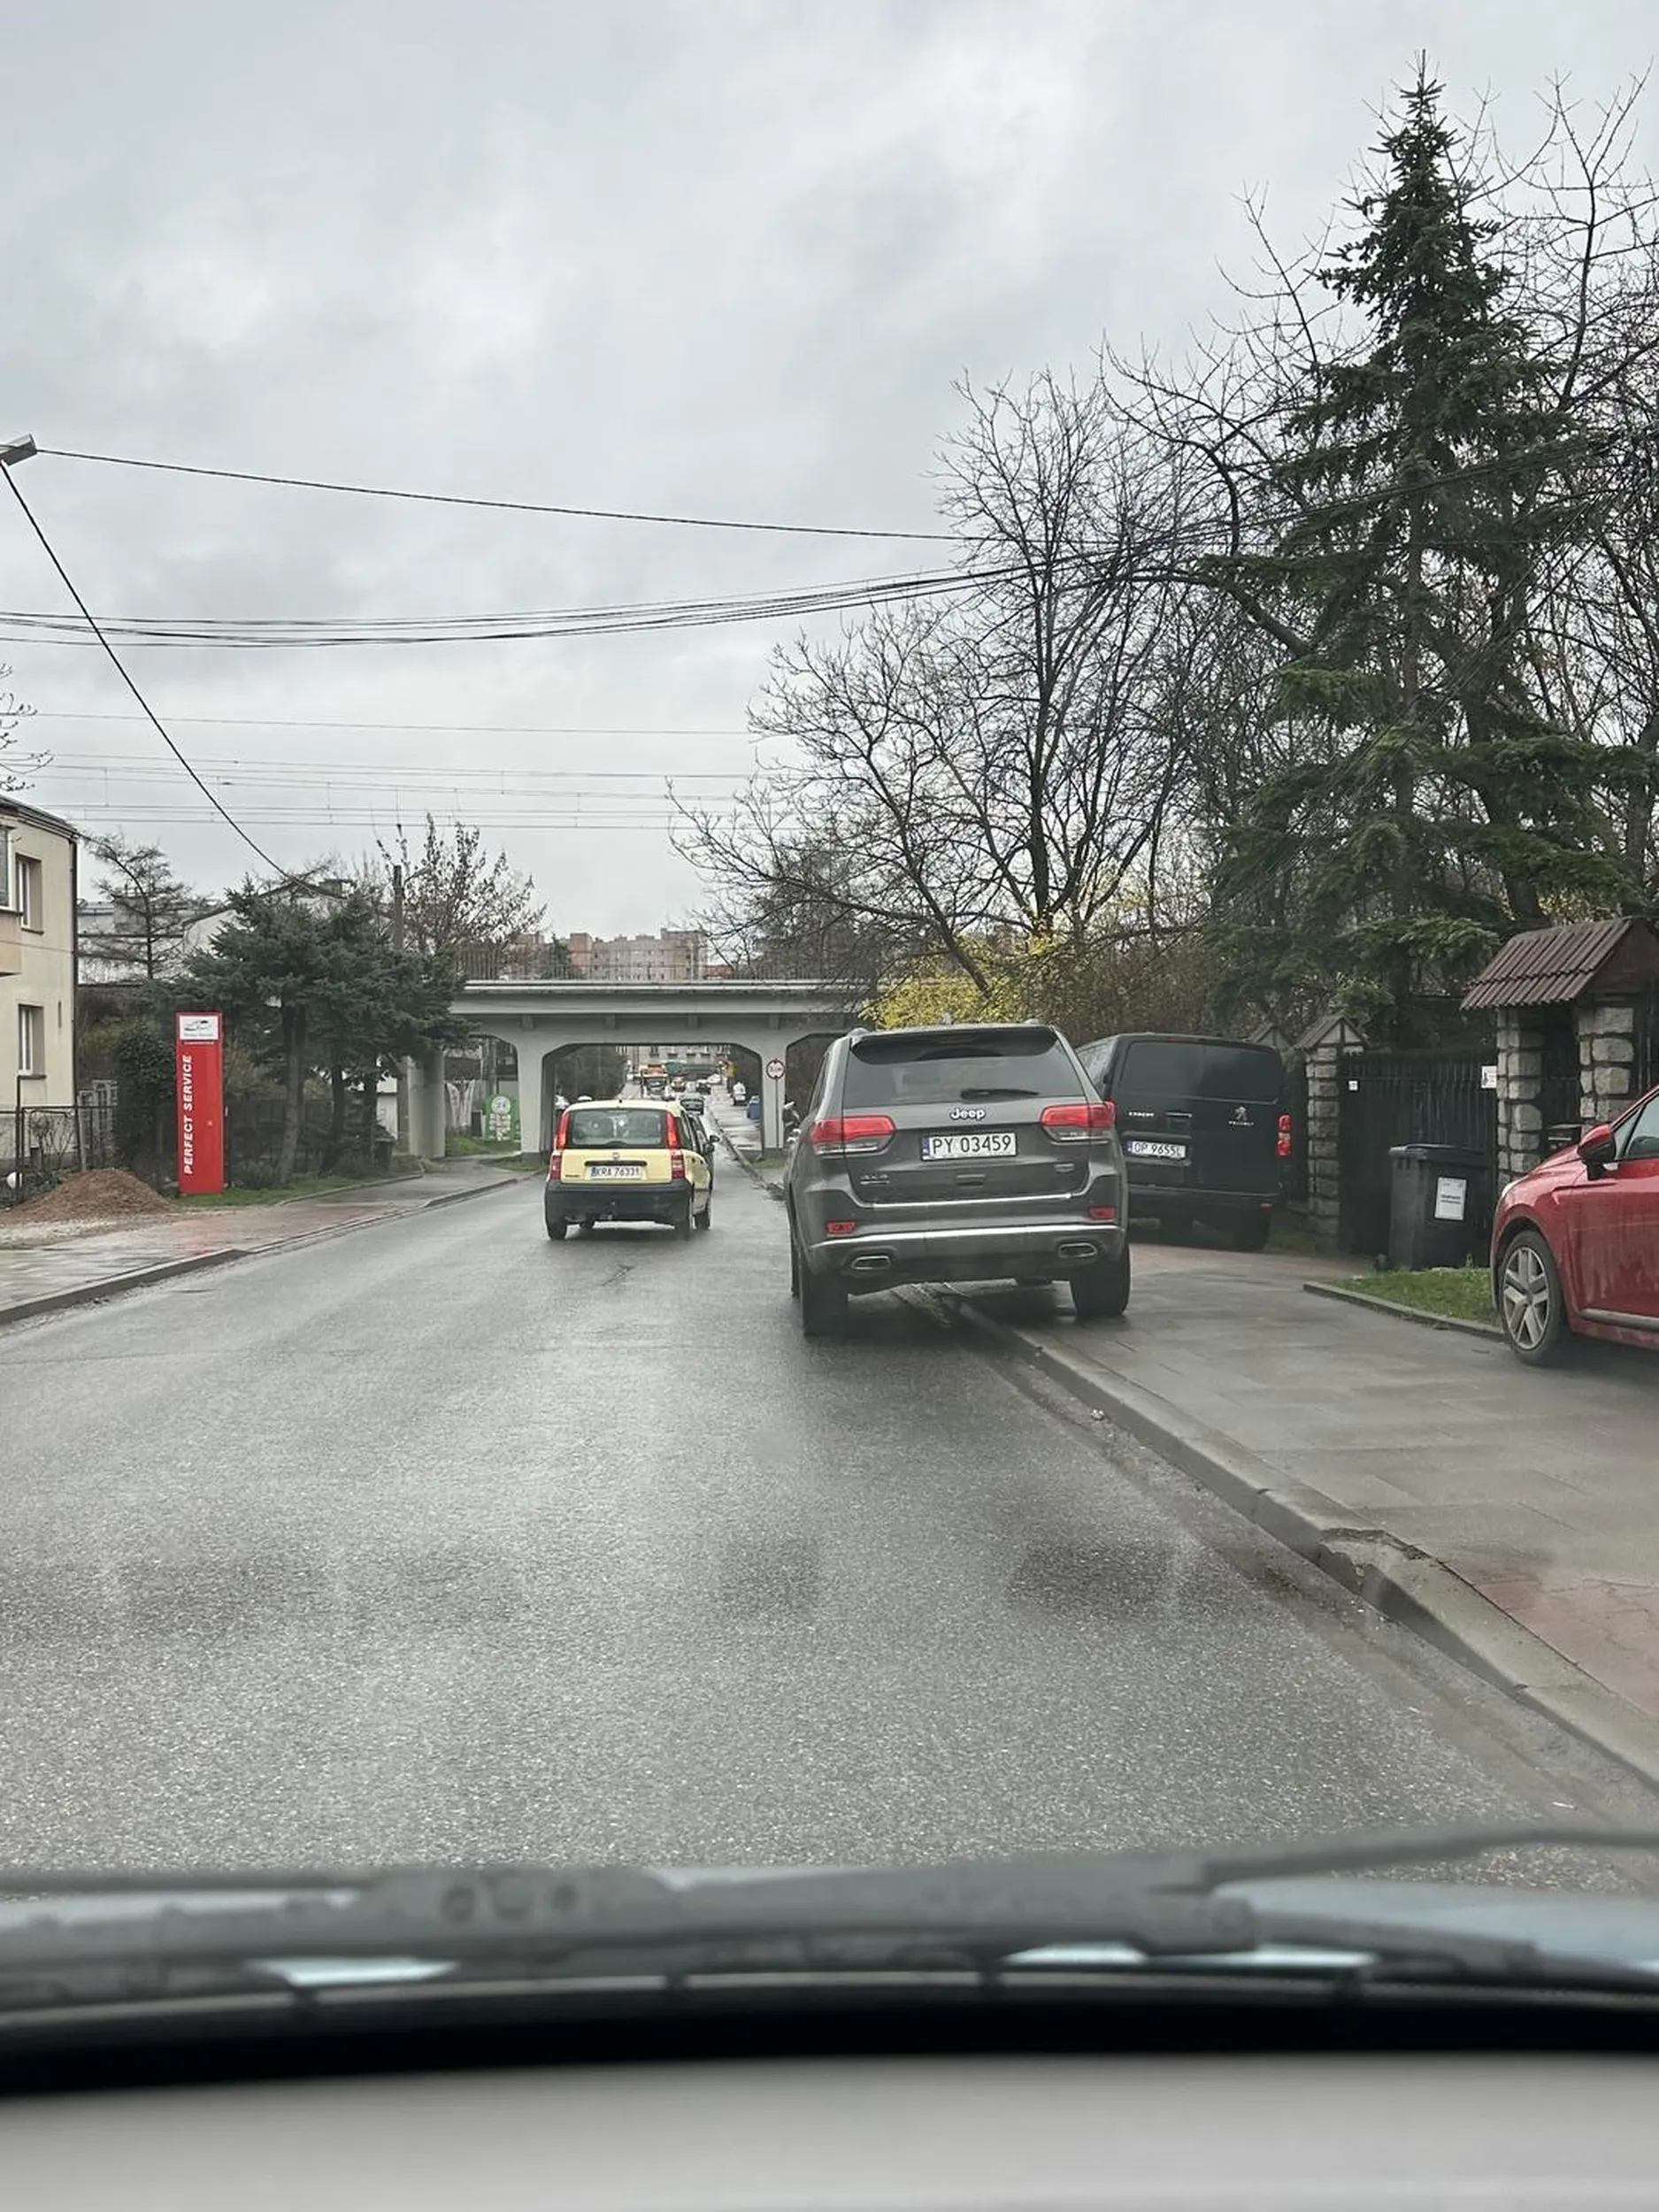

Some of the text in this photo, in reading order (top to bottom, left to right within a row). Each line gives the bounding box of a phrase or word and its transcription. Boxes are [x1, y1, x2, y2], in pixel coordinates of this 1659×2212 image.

[182, 1055, 193, 1174] PERFECT SERVICE
[950, 1108, 987, 1121] Jeep
[933, 1135, 1011, 1154] PY 03459
